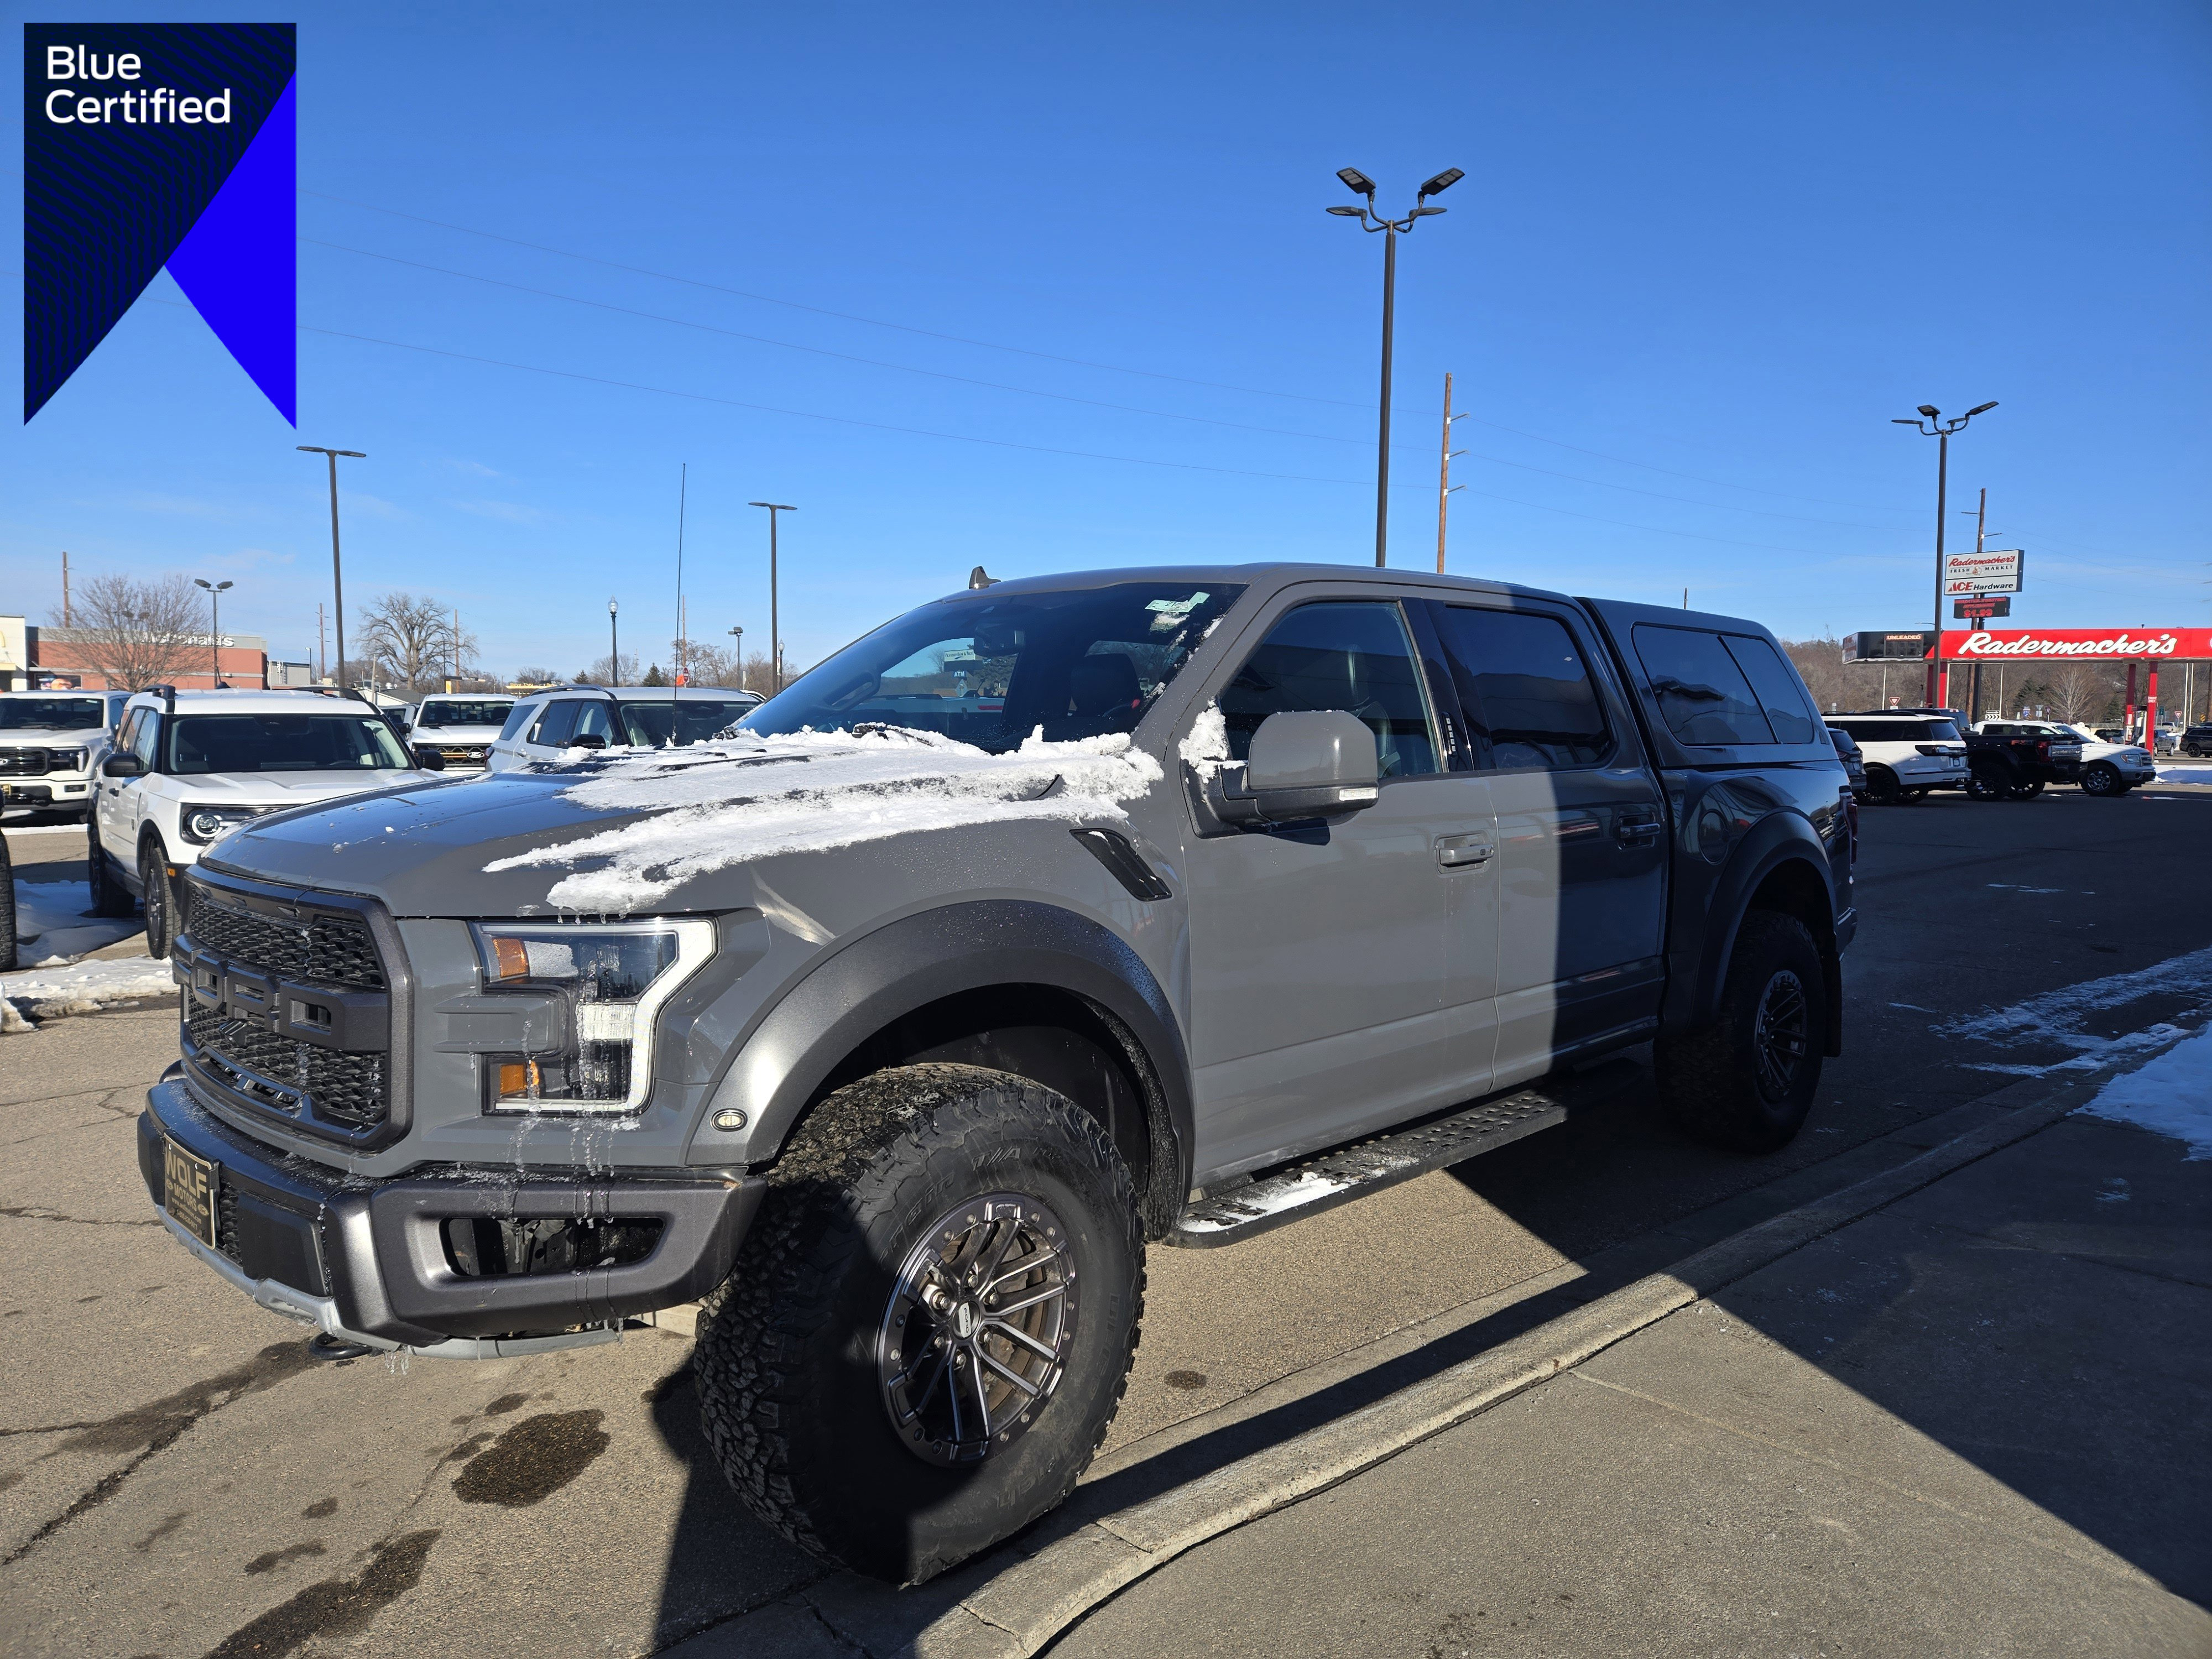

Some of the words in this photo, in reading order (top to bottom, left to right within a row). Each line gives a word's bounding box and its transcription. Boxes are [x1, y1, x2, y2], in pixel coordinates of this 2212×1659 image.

[1948, 555, 2016, 567] Radermacher's
[1948, 582, 1974, 592] ACE
[1958, 632, 2177, 655] Radermacher's
[166, 1150, 207, 1199] WOLF
[173, 1182, 197, 1212] MOTORS
